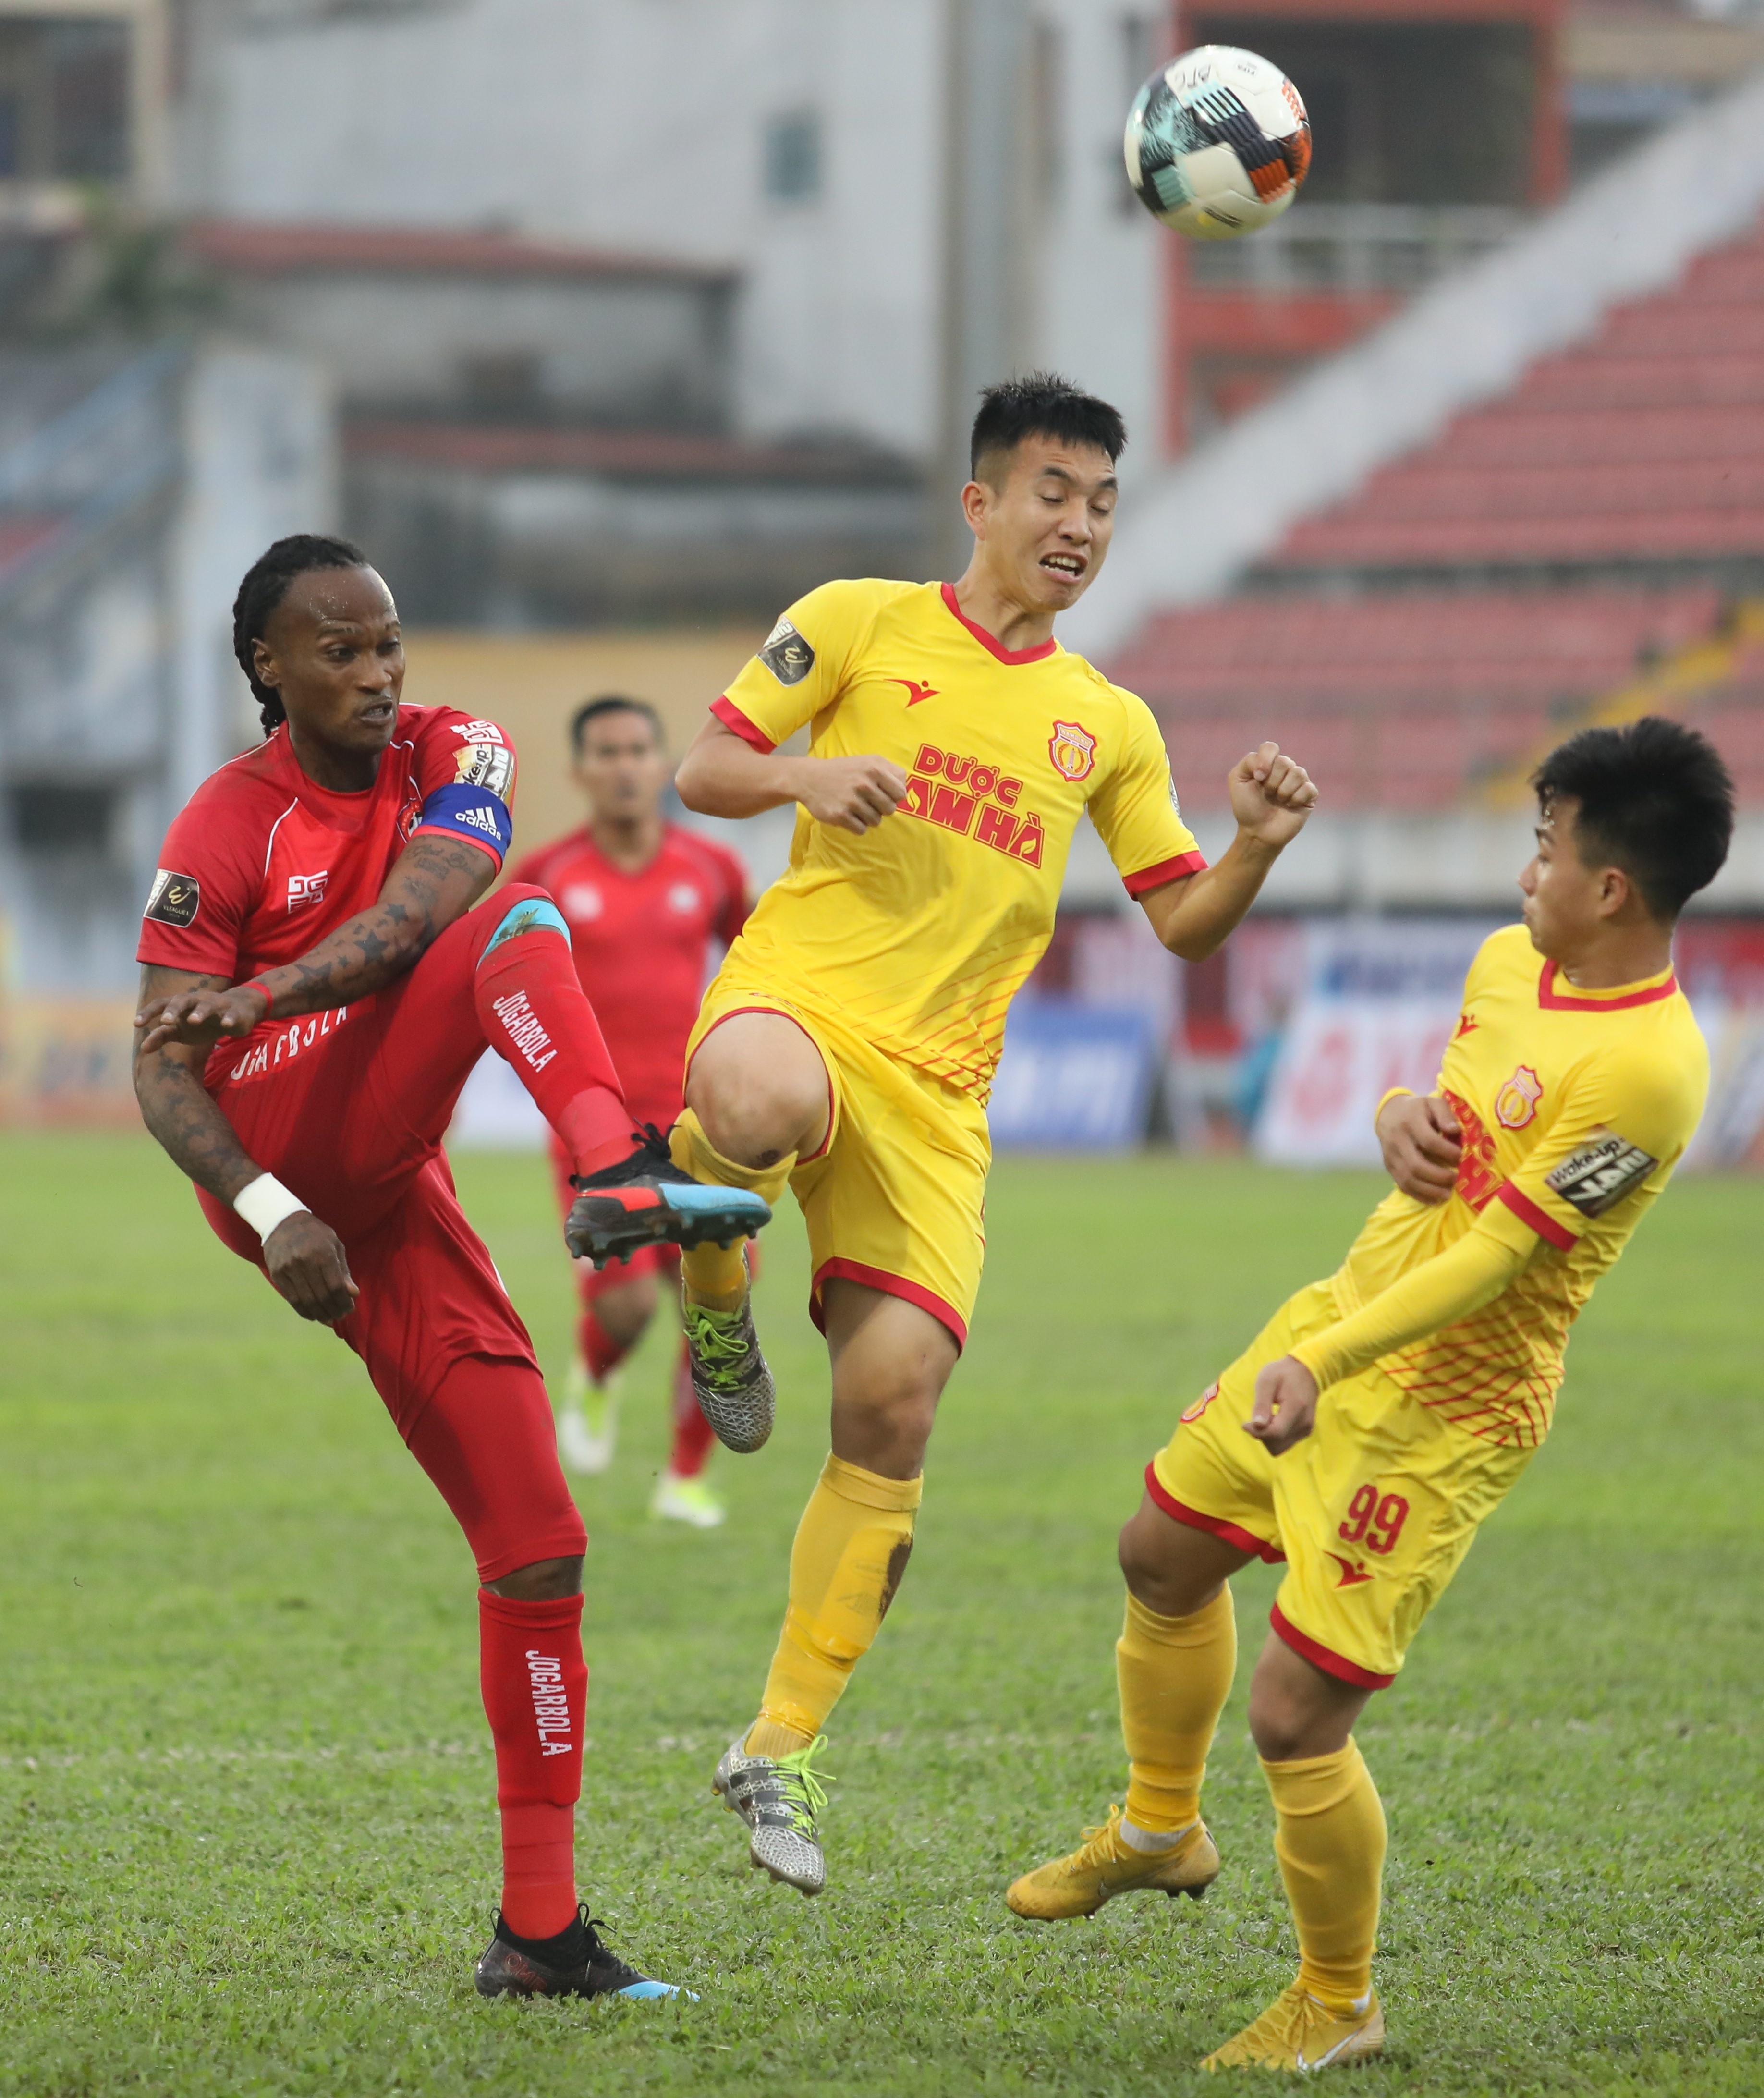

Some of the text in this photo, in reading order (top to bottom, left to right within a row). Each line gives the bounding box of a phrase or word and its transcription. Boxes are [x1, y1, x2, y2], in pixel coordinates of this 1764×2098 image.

[913, 743, 1023, 809] DƯỢC
[455, 812, 502, 841] adidas
[896, 774, 1045, 869] AM HÀ
[492, 990, 558, 1073] JOGARBOLA
[1566, 1148, 1651, 1201] 247
[1338, 1484, 1410, 1555] 99
[525, 1649, 573, 1756] JOGARBOLA
